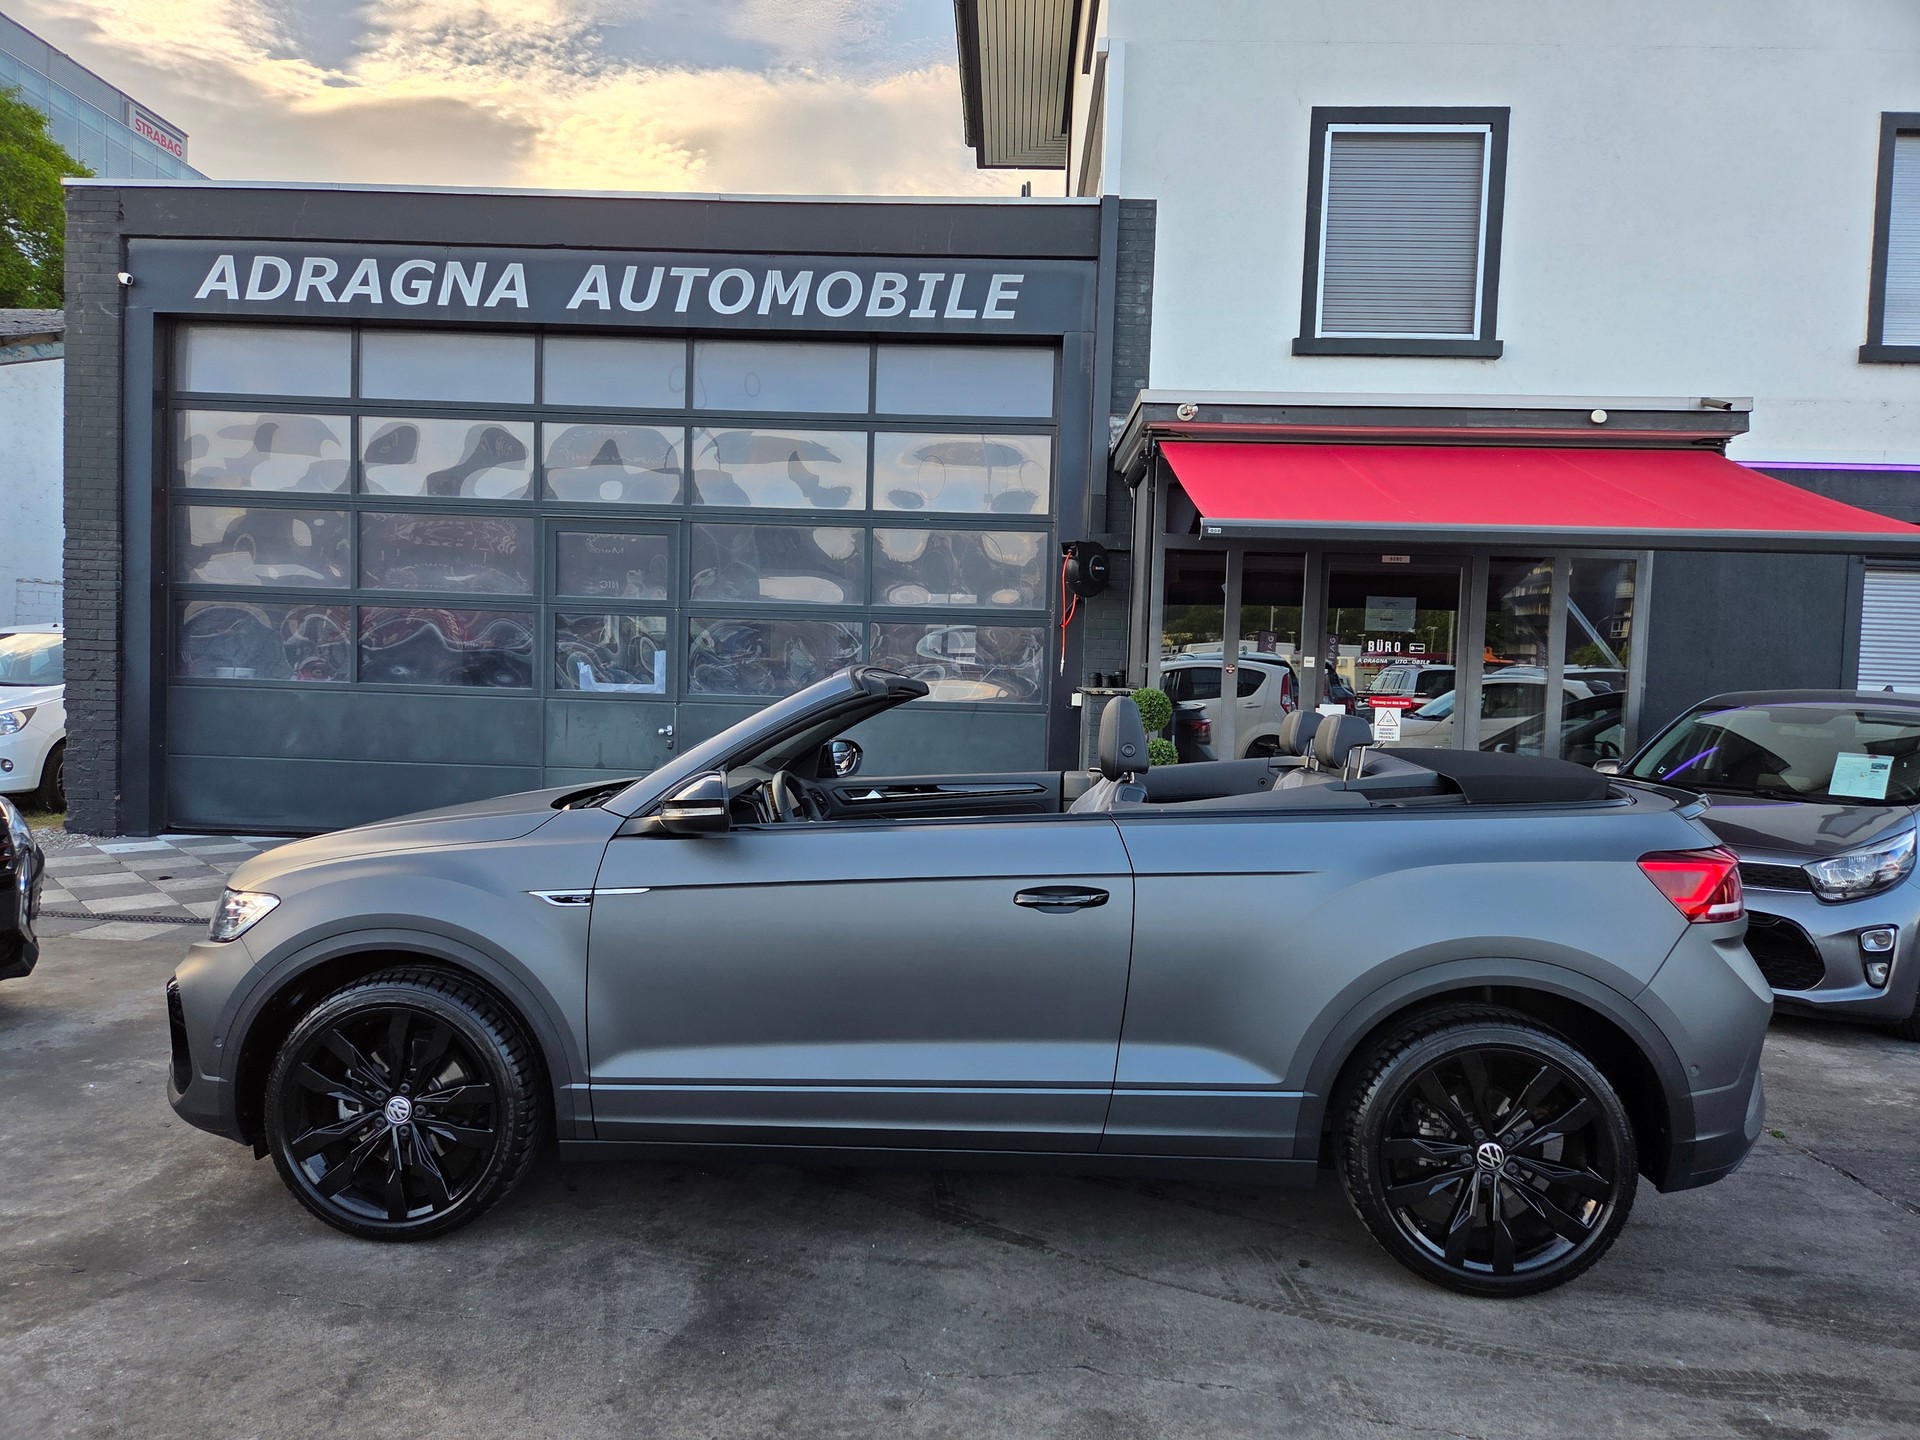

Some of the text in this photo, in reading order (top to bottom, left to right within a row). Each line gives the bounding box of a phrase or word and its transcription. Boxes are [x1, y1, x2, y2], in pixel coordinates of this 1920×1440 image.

[135, 117, 183, 157] STRABAG
[194, 254, 1025, 320] ADRAGNA AUTOMOBILE
[1367, 639, 1401, 653] BÜRO
